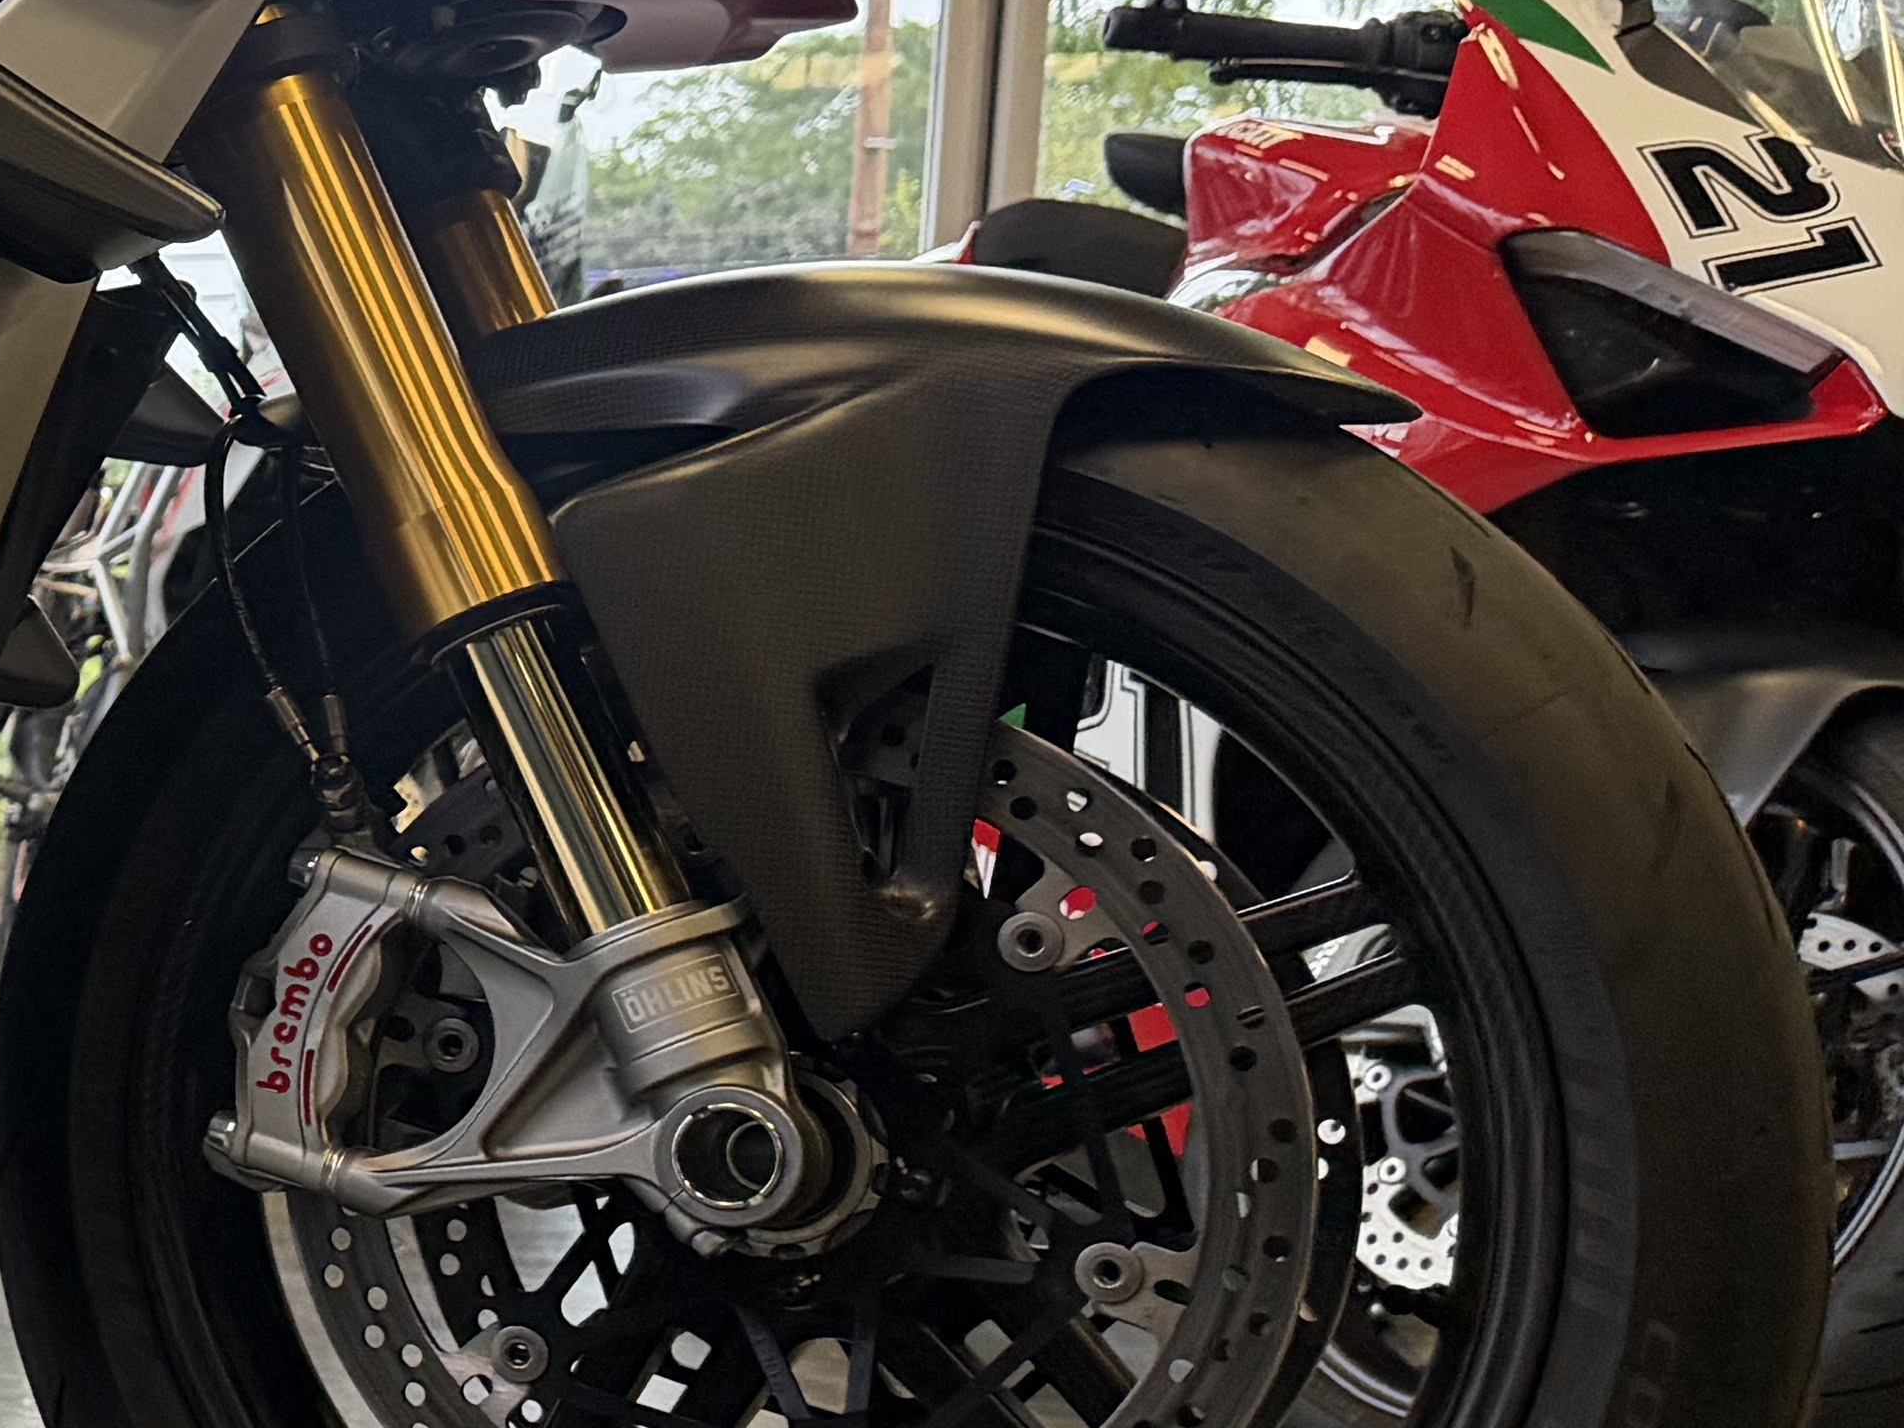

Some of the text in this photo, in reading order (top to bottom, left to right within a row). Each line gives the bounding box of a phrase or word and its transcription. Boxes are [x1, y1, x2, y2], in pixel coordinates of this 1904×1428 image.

[1639, 131, 1882, 296] 21
[255, 933, 333, 1094] brembo
[624, 964, 731, 1025] ÖHLINS
